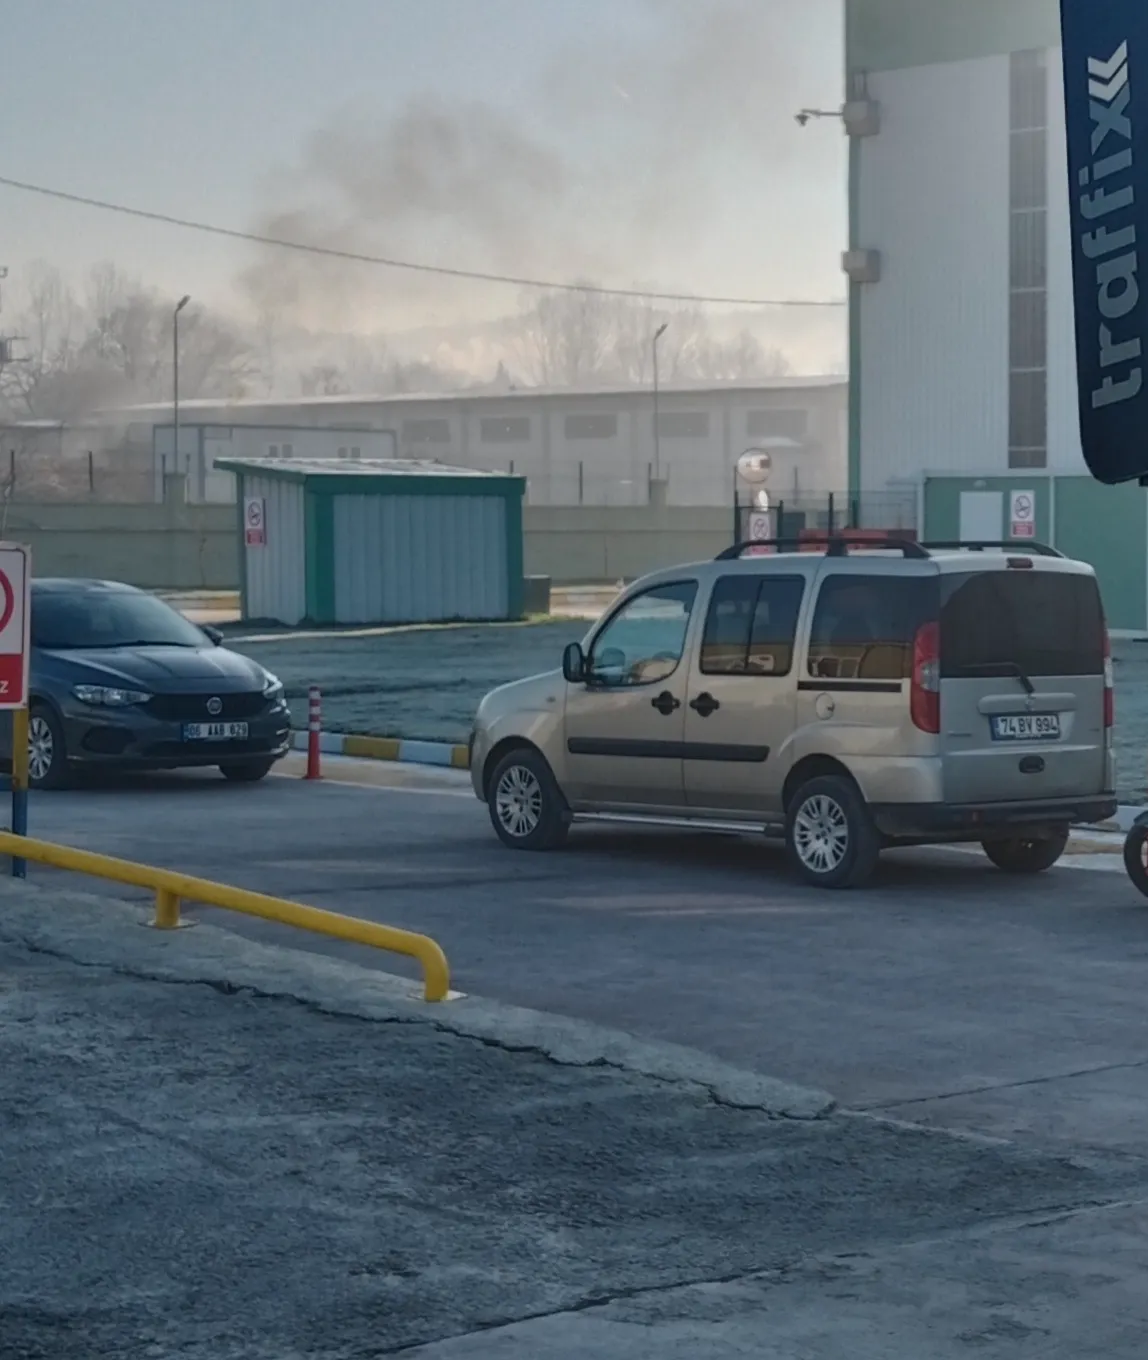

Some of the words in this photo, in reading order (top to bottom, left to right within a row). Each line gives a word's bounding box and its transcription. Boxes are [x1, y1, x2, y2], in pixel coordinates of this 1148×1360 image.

[1079, 82, 1143, 408] traffix
[1000, 717, 1017, 733] 74
[1018, 717, 1032, 733] BV
[1035, 716, 1058, 732] 994
